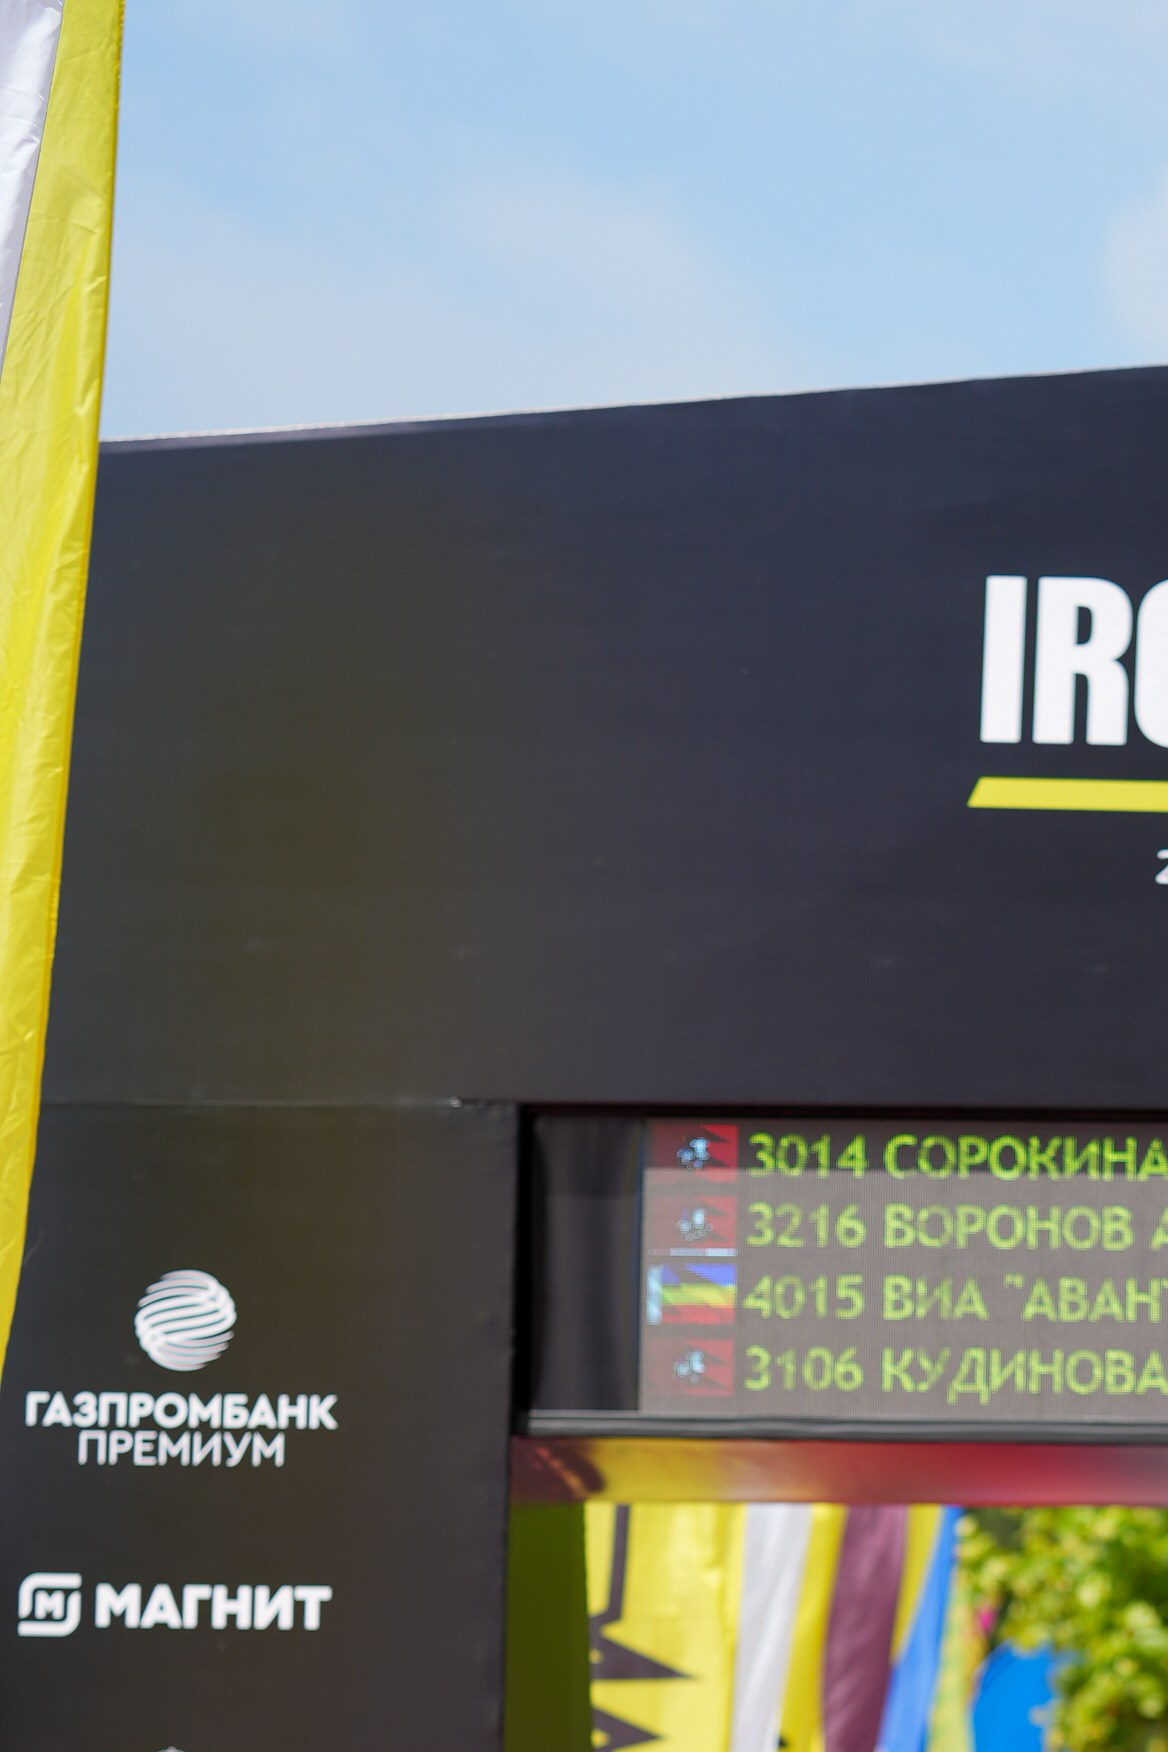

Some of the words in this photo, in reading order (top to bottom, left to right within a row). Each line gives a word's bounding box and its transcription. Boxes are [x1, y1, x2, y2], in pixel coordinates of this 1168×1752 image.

[748, 1133, 867, 1179] 3014
[747, 1202, 867, 1248] 3216
[884, 1203, 1134, 1251] ВОРОНОВ
[743, 1273, 865, 1320] 4015
[883, 1274, 989, 1321] ВИА
[745, 1345, 864, 1391] 3106
[25, 1391, 337, 1430] ГАЗПРОМБАНК
[78, 1430, 285, 1467] ПРЕМИУМ
[95, 1584, 332, 1631] МАГНИТ
